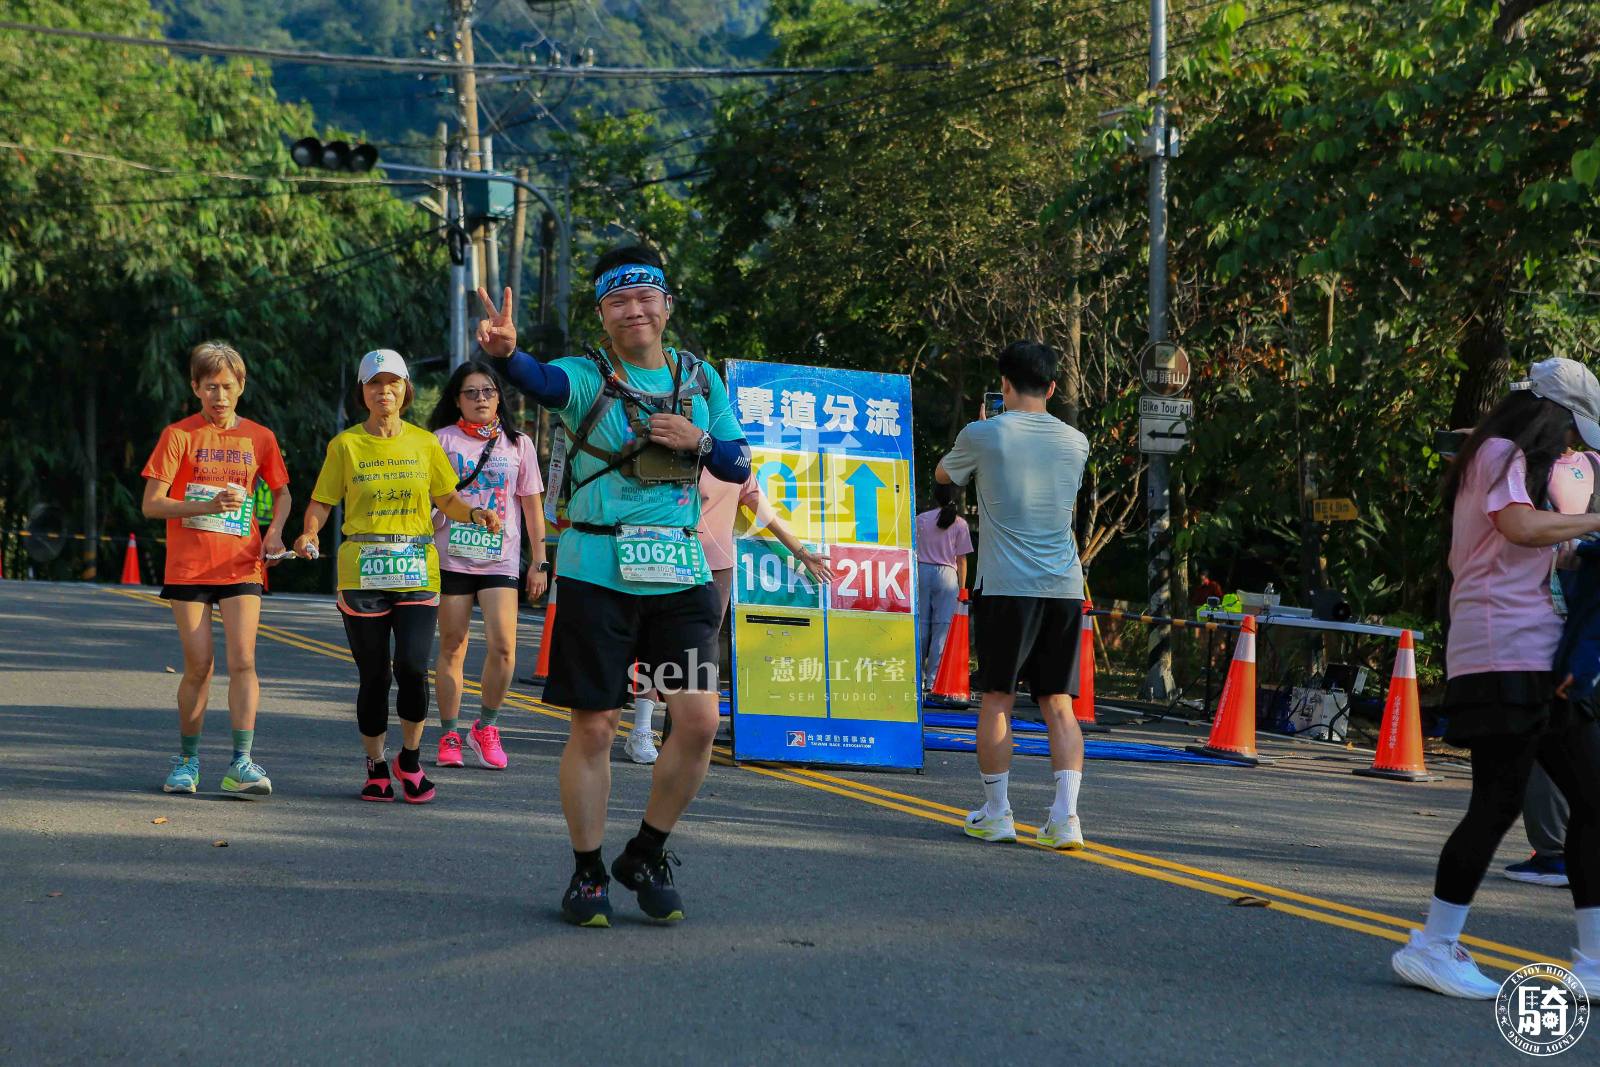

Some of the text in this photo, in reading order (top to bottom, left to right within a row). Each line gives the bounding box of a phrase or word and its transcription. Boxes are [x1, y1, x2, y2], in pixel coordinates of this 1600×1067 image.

[737, 386, 901, 437] 賽道分流
[1142, 400, 1159, 413] Bike
[1161, 402, 1178, 414] Tour
[194, 448, 253, 465] 視障跑者
[358, 459, 385, 469] Guide
[450, 530, 501, 548] 40065
[620, 542, 688, 566] 30621
[361, 557, 420, 575] 40102
[741, 553, 816, 595] 10K
[837, 558, 906, 600] 21K
